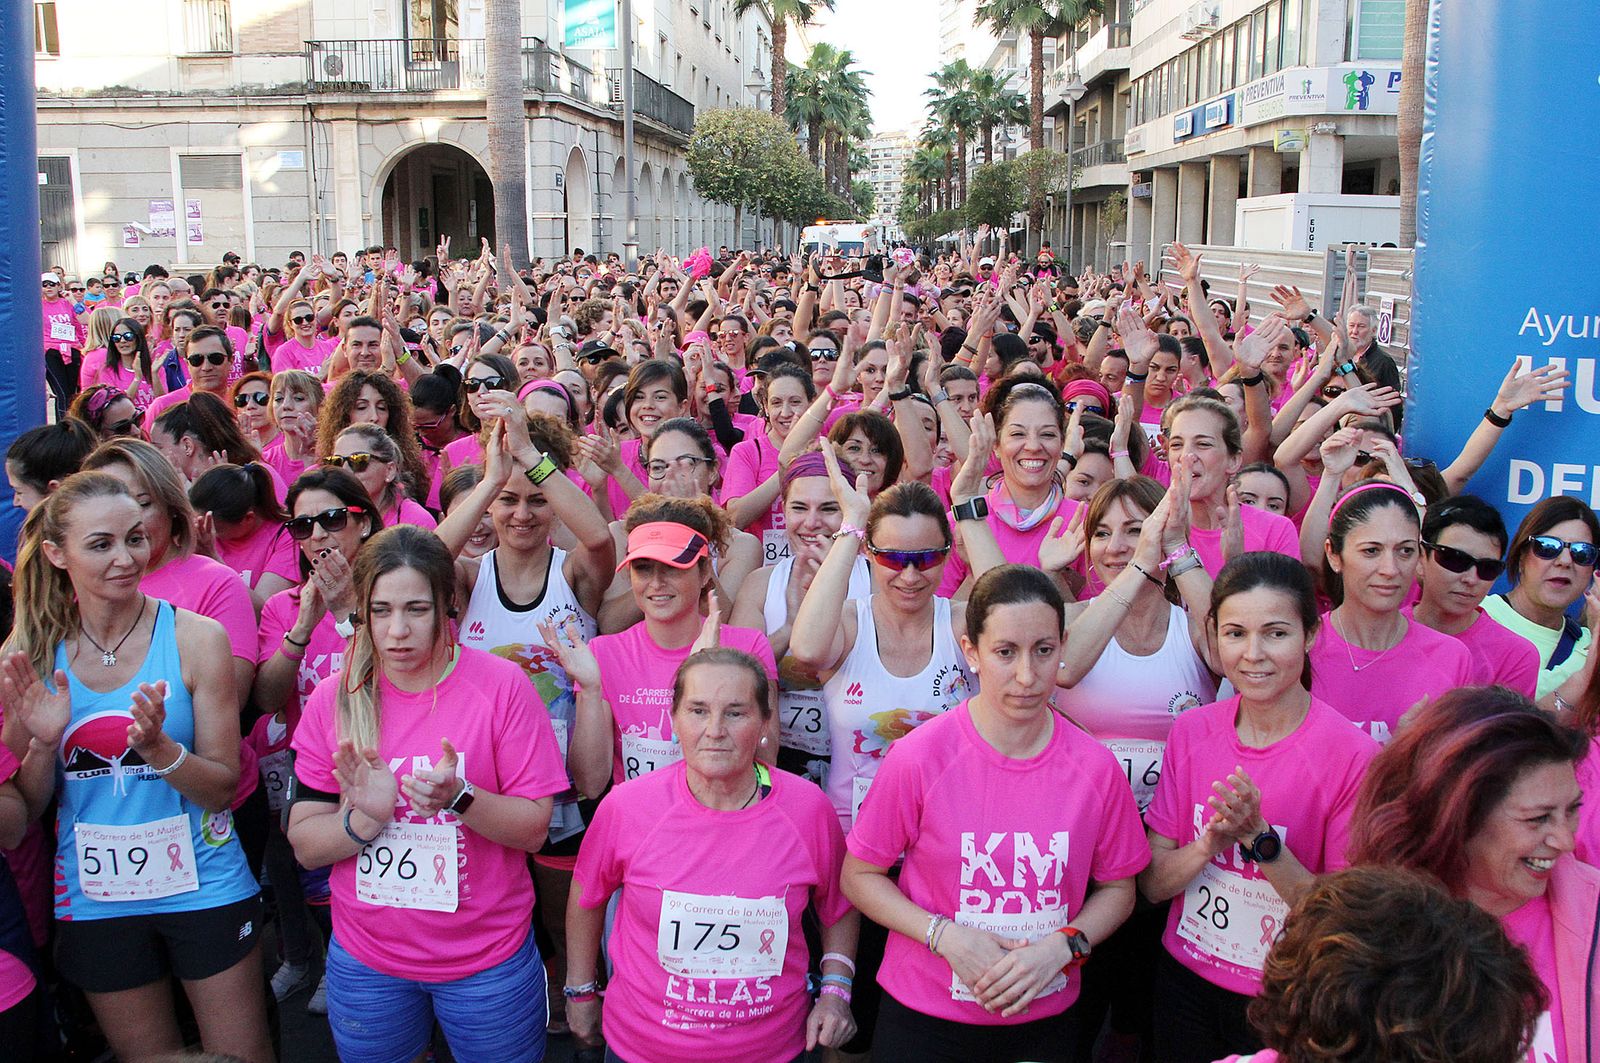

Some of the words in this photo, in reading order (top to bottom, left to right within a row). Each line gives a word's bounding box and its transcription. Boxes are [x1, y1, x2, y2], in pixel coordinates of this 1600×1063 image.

[1245, 75, 1285, 103] PREVENTIVA
[933, 665, 949, 697] DIOSAS
[618, 694, 630, 704] DE
[632, 696, 643, 705] LA
[788, 706, 822, 733] 73
[636, 743, 667, 756] Carrera
[669, 748, 680, 756] de
[1147, 746, 1158, 754] de
[76, 768, 111, 779] CLUB
[124, 765, 144, 775] Ultra
[93, 831, 126, 841] Carrera
[129, 832, 142, 840] de
[145, 829, 154, 838] la
[157, 823, 185, 836] Mujer
[377, 832, 398, 840] rrera
[400, 832, 412, 840] de
[414, 832, 423, 841] la
[425, 833, 451, 845] Mujer
[83, 846, 149, 876] 519
[359, 844, 417, 880] 596
[960, 831, 1069, 888] KM
[1202, 868, 1227, 890] Carrera
[1229, 884, 1241, 896] de
[1243, 885, 1253, 898] la
[1255, 891, 1285, 907] Mujer
[684, 902, 724, 916] Carrera
[727, 907, 740, 917] de
[743, 907, 752, 917] la
[755, 909, 783, 919] Mujer
[1196, 885, 1230, 930] 28
[670, 920, 741, 951] 175
[977, 921, 1018, 932] Carrera
[1021, 922, 1034, 932] de
[1036, 921, 1045, 930] la
[665, 975, 772, 1005] ELLAS
[719, 1008, 731, 1019] de
[736, 1008, 745, 1018] la
[748, 1004, 774, 1017] Mujer
